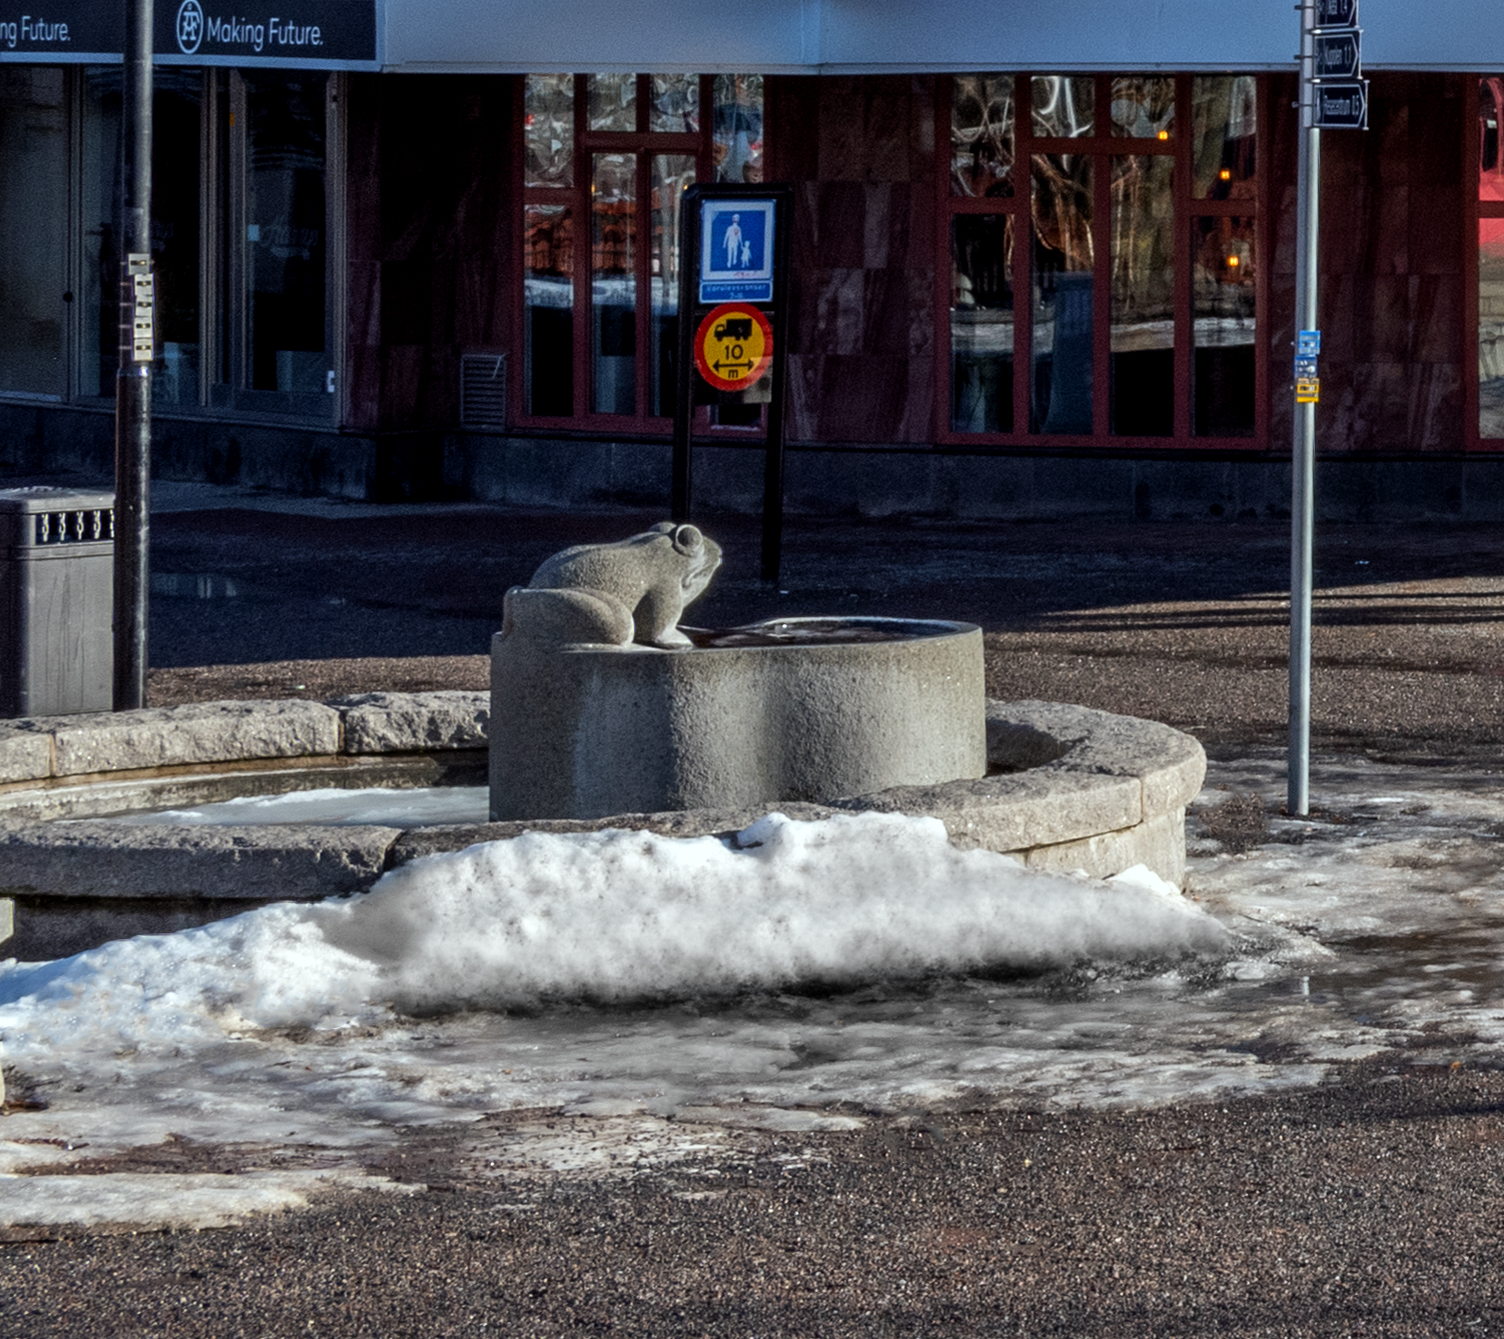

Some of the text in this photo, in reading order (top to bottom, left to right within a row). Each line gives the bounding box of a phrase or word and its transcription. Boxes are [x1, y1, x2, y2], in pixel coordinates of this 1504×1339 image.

[21, 15, 71, 42] Future.
[207, 17, 264, 52] Making
[268, 17, 324, 46] Future.
[725, 344, 743, 360] 10
[728, 369, 738, 379] m
